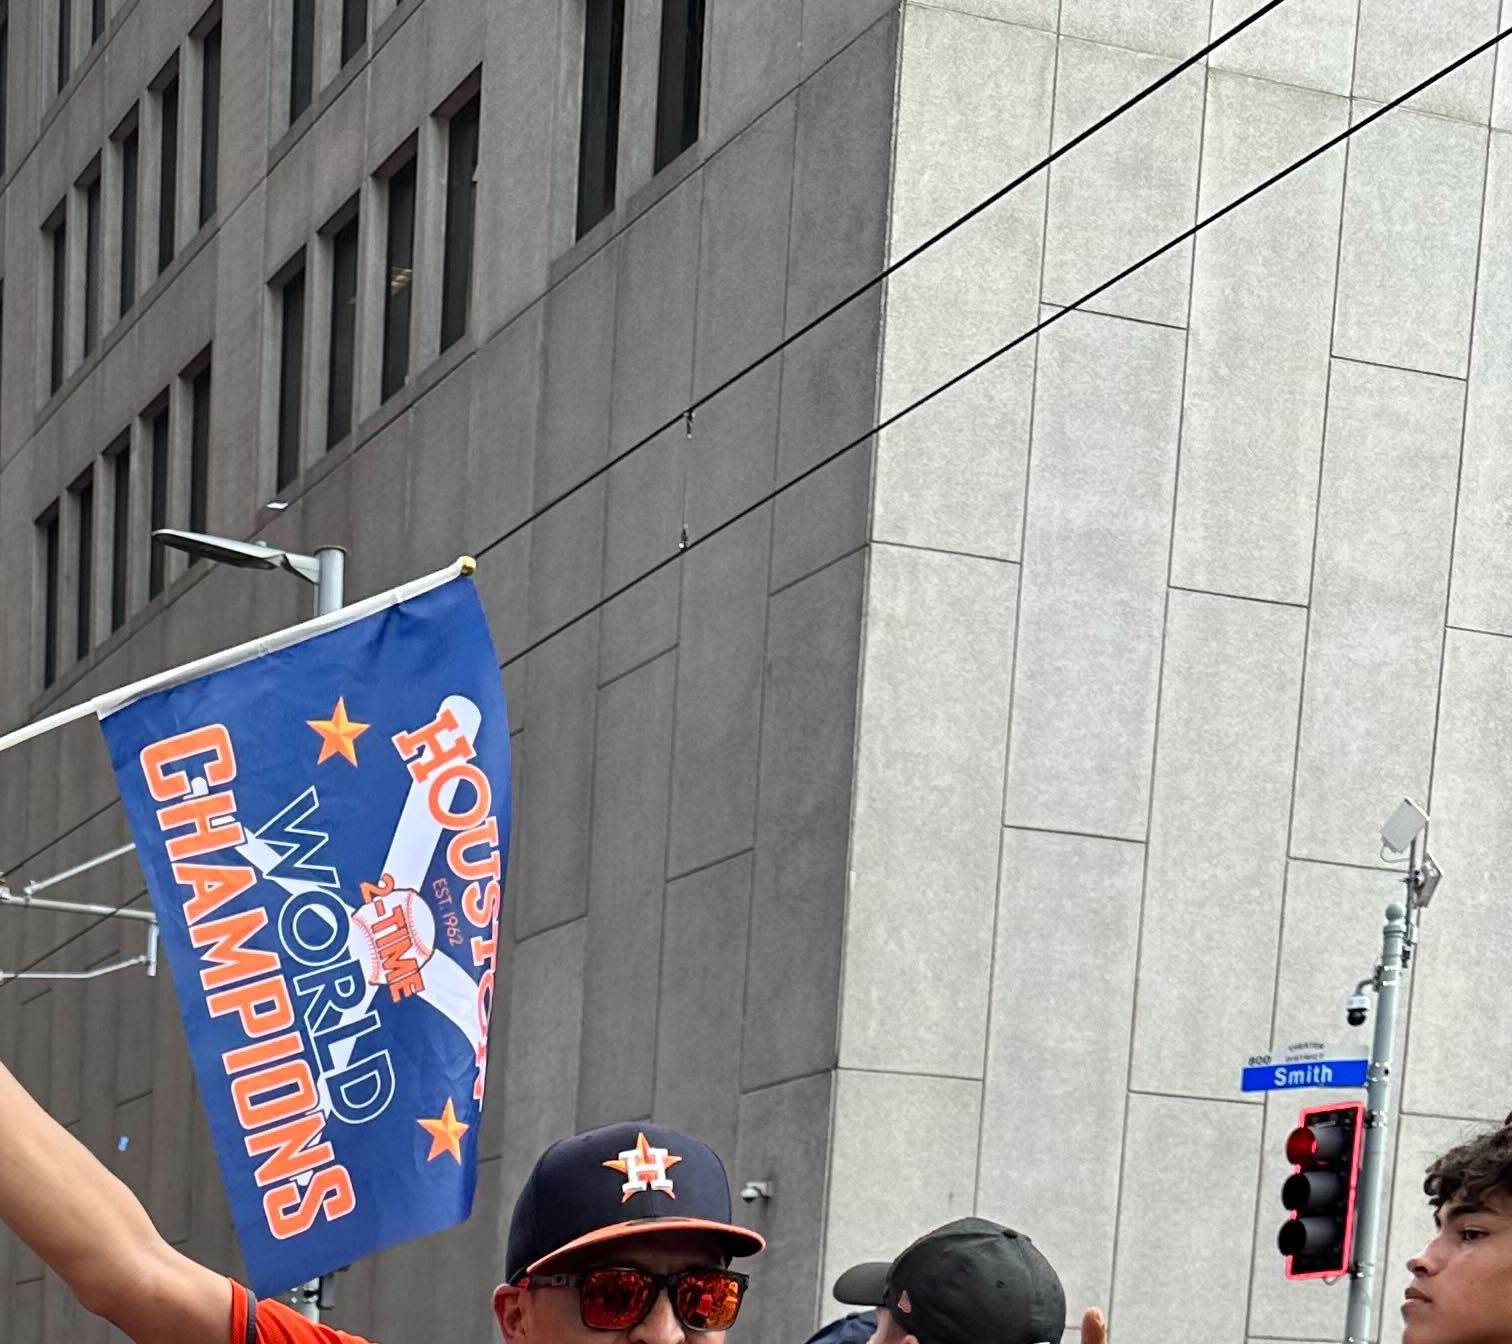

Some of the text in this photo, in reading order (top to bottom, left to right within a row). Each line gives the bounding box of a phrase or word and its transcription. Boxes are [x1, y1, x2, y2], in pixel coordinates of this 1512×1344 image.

[140, 724, 356, 1239] CHAMPIONS
[254, 786, 396, 1124] WORLD
[360, 873, 425, 1002] 2-TIME
[392, 708, 500, 1111] HOUSTO
[433, 878, 463, 945] EST. 1962
[1274, 1064, 1333, 1087] Smith
